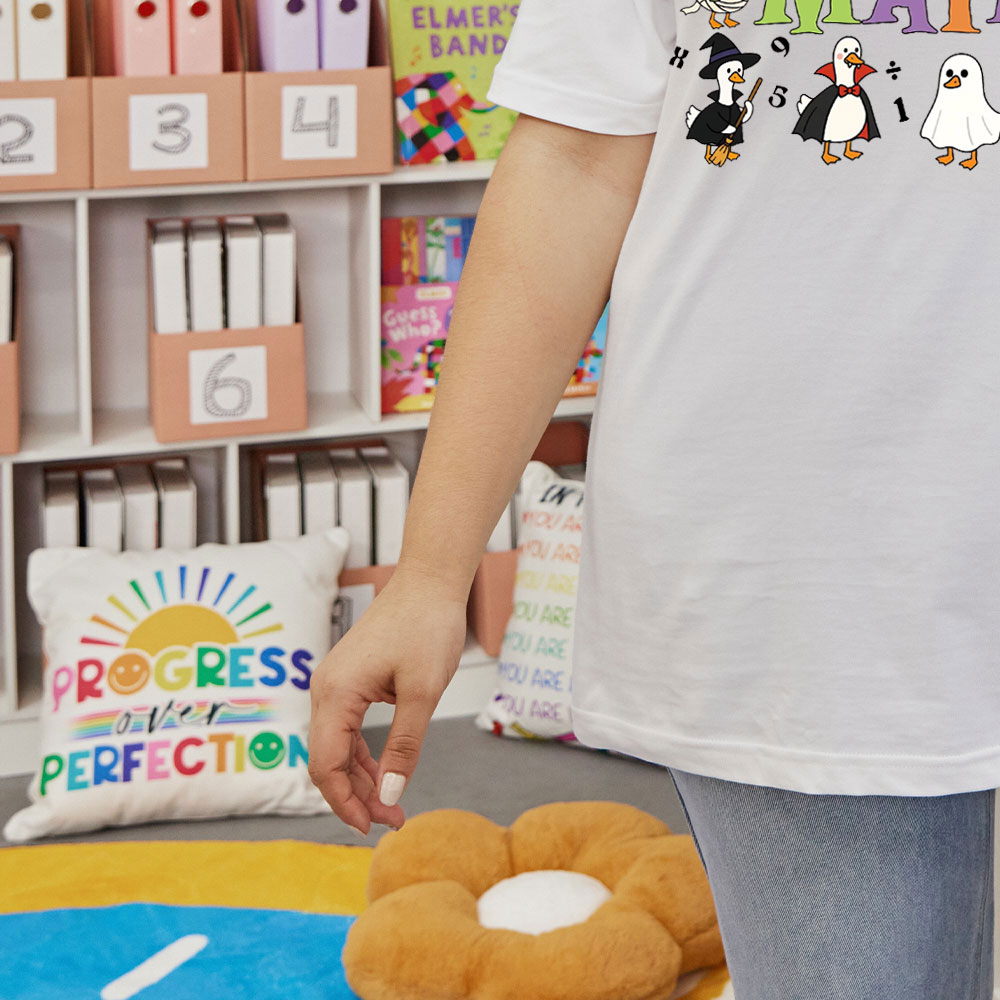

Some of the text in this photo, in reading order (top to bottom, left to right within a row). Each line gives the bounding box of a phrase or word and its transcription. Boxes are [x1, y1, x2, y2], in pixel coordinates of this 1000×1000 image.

[430, 34, 507, 58] BAND
[768, 85, 788, 108] 5
[152, 103, 192, 154] 3
[291, 96, 339, 148] 4
[0, 113, 34, 164] 2
[384, 306, 438, 327] Guess
[388, 318, 442, 343] Who?
[204, 353, 252, 418] 6
[541, 605, 572, 628] ARE
[535, 636, 567, 660] ARE
[52, 646, 315, 712] PROGRESS
[531, 668, 564, 692] ARE
[116, 700, 230, 735] over
[529, 699, 562, 722] ARE
[40, 731, 309, 797] PERFECTION
